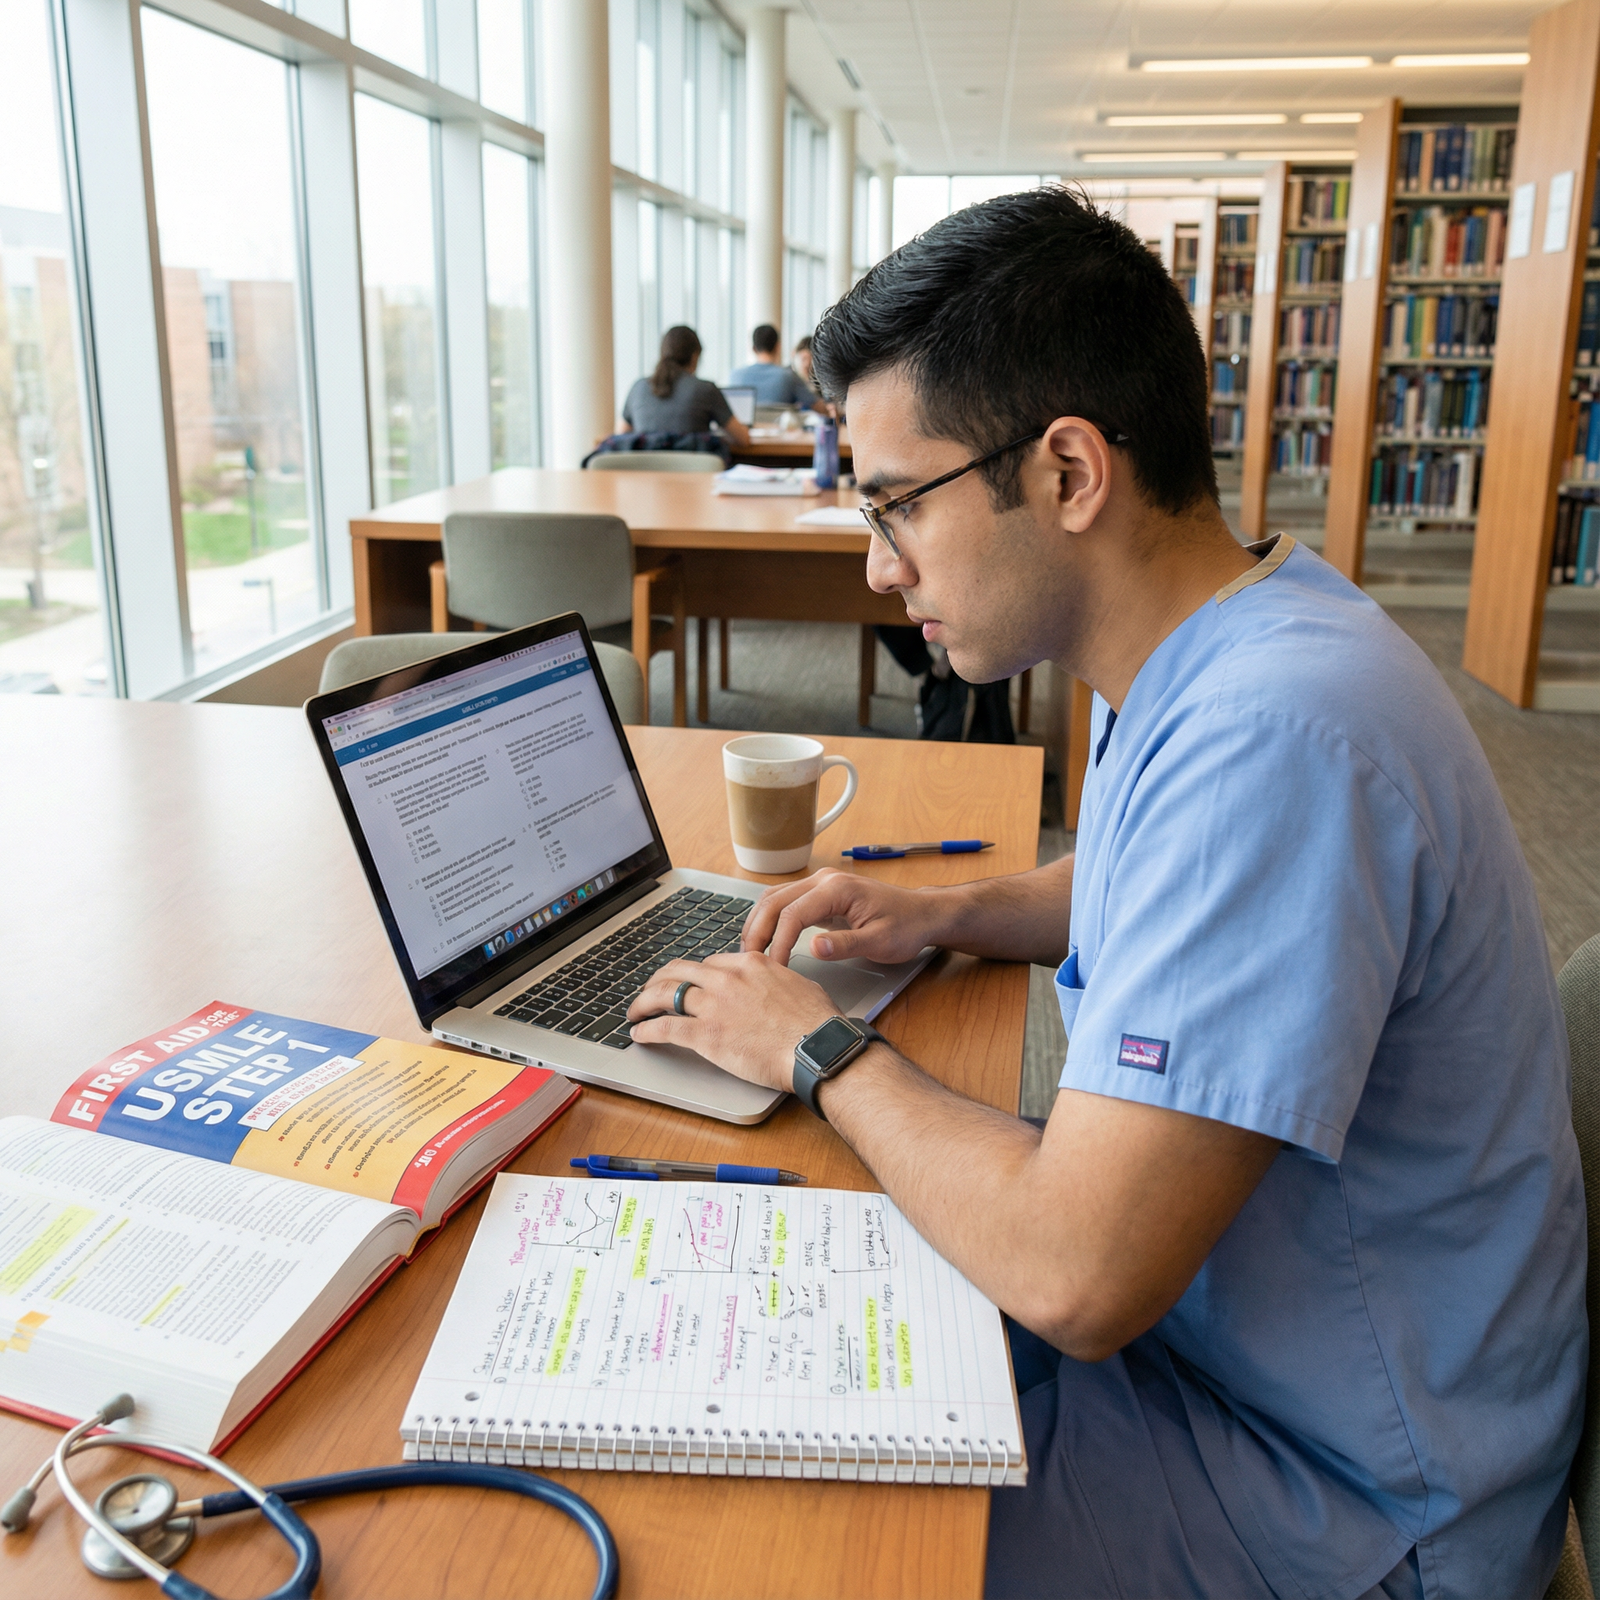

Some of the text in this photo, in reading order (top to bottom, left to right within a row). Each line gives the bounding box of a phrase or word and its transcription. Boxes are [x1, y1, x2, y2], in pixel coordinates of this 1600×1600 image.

[67, 1026, 210, 1122] FIRST AID
[121, 1022, 289, 1121] USMLE
[183, 1053, 294, 1125] STEP
[287, 1039, 331, 1053] 1
